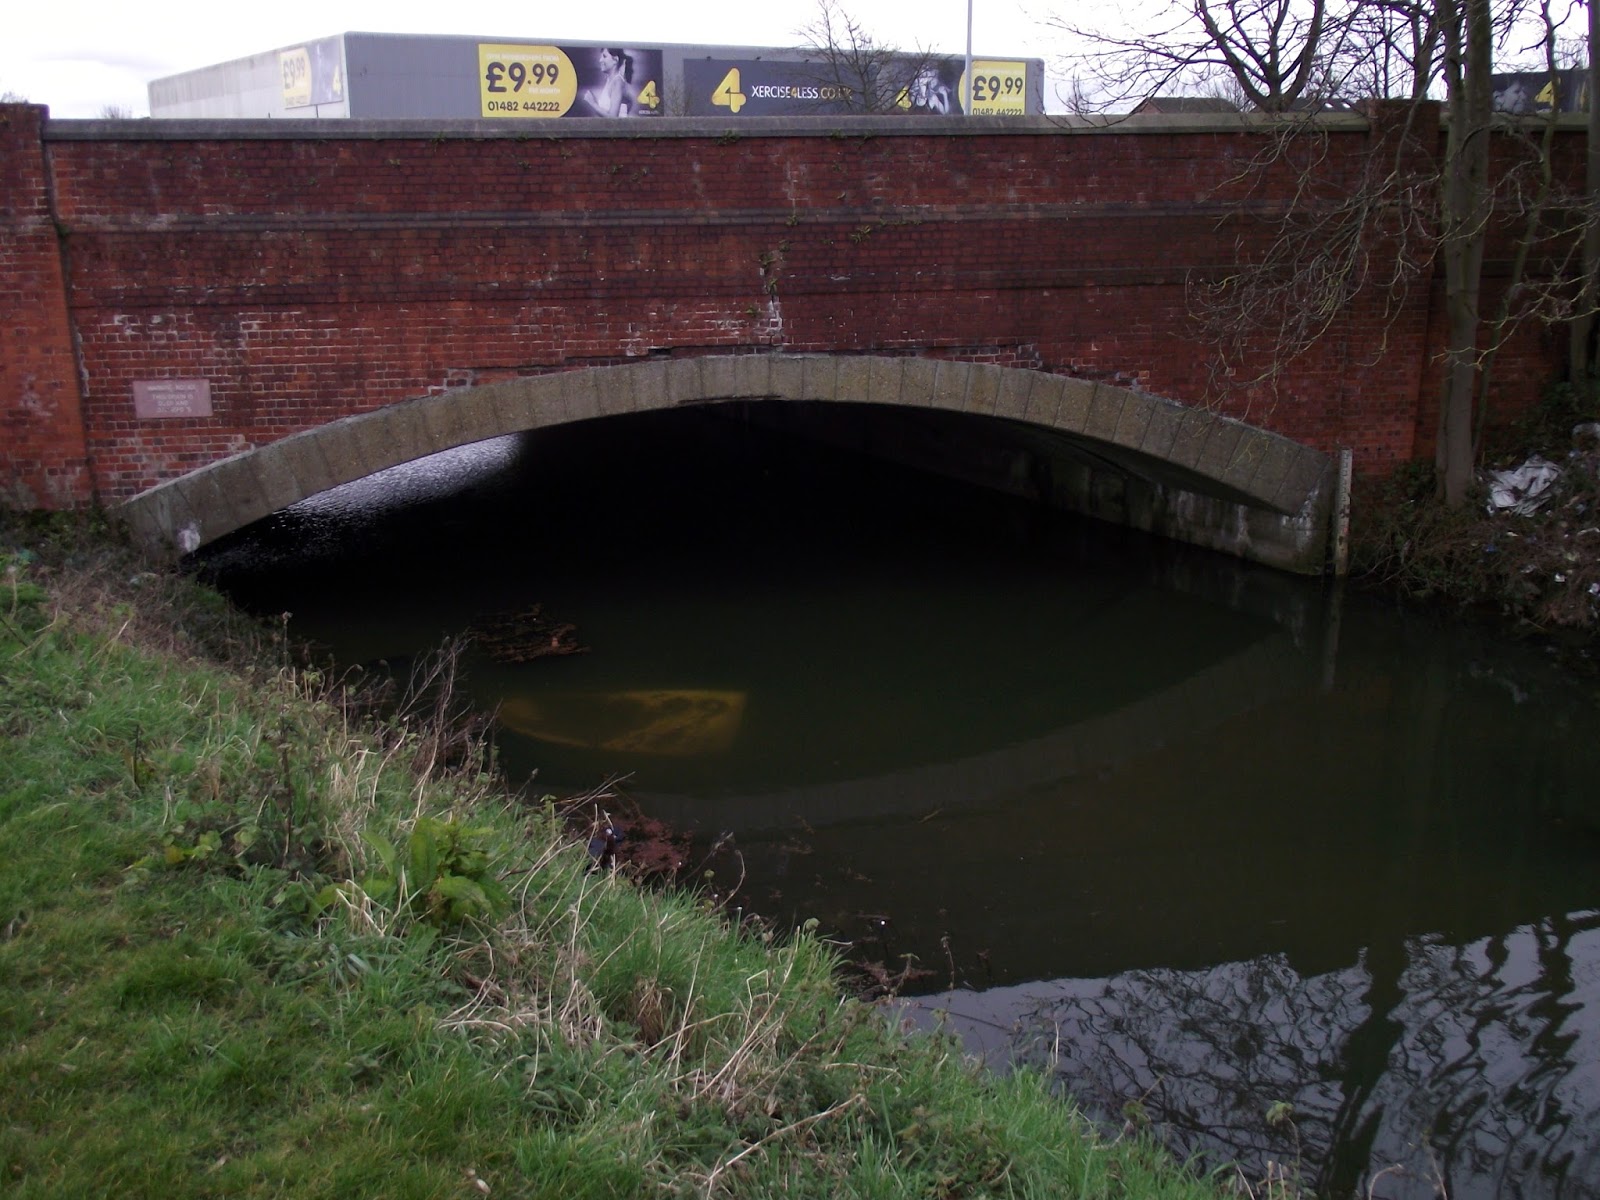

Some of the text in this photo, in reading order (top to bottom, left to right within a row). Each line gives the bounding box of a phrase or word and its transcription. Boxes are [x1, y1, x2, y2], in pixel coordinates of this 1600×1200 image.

[485, 61, 559, 93] £9.99
[711, 67, 747, 114] 4
[972, 75, 1023, 101] £9.99
[487, 100, 560, 112] 01482 442222
[637, 80, 661, 109] 4
